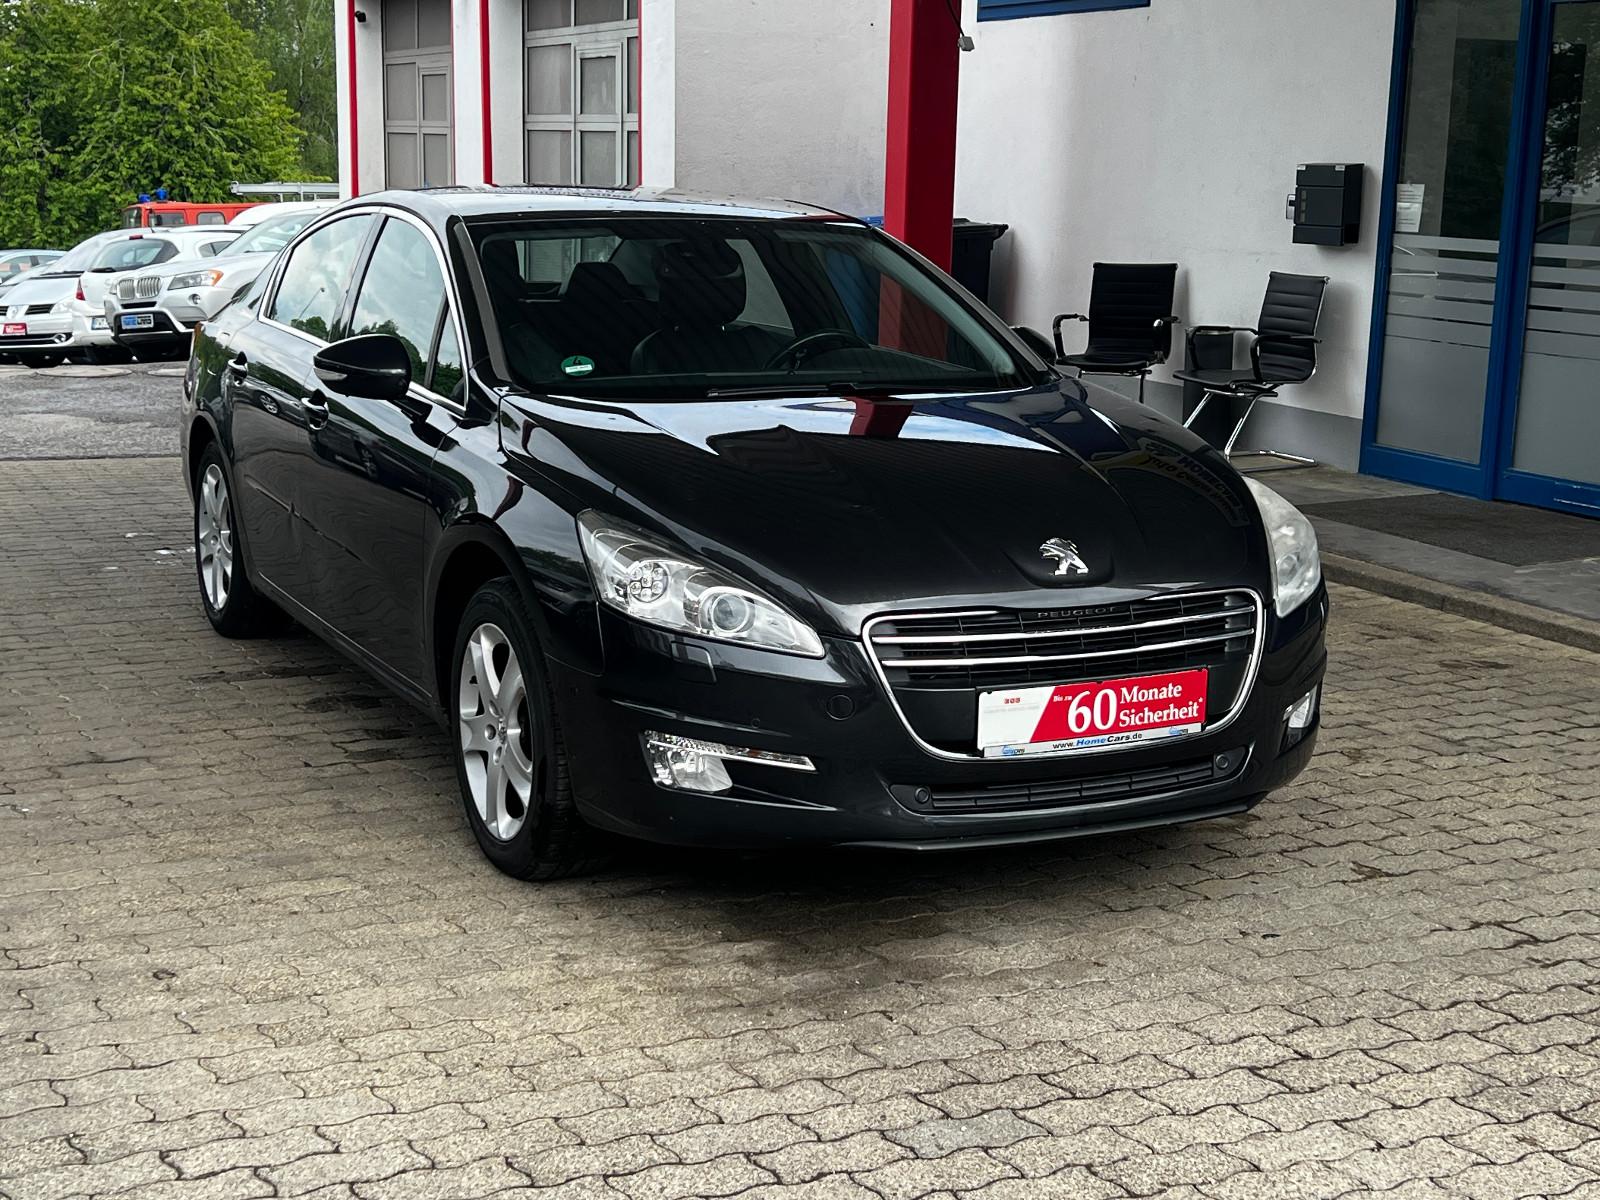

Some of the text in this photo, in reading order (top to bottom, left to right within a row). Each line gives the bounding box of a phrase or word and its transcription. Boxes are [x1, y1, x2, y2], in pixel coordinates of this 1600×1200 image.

[1037, 606, 1117, 618] PEUGEOT
[1119, 683, 1182, 704] Monate
[1068, 688, 1117, 733] 60
[1052, 732, 1143, 750] www.HomeCars.de
